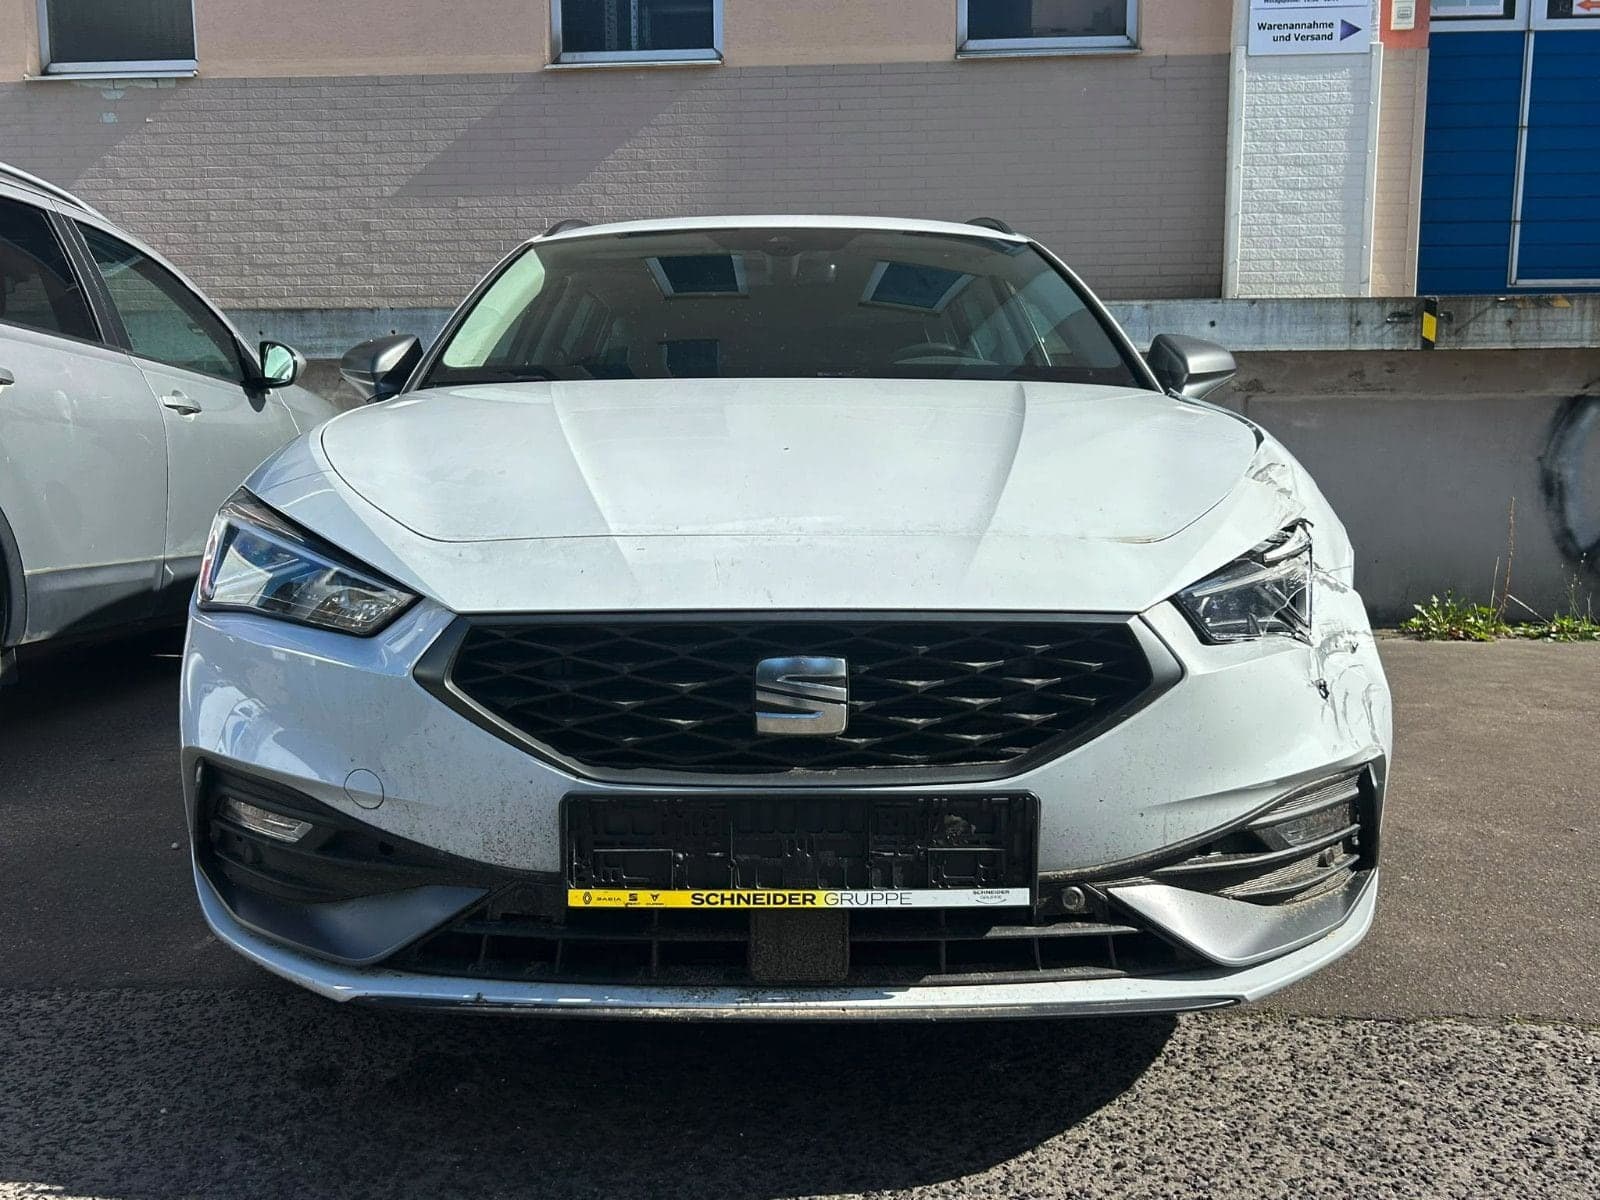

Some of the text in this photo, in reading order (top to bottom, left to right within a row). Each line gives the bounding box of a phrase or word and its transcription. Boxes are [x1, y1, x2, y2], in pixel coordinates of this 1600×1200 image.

[1257, 20, 1334, 31] Warenannahme
[1272, 32, 1333, 42] und Versand
[691, 892, 912, 906] SCHNEIDER GRUPPE
